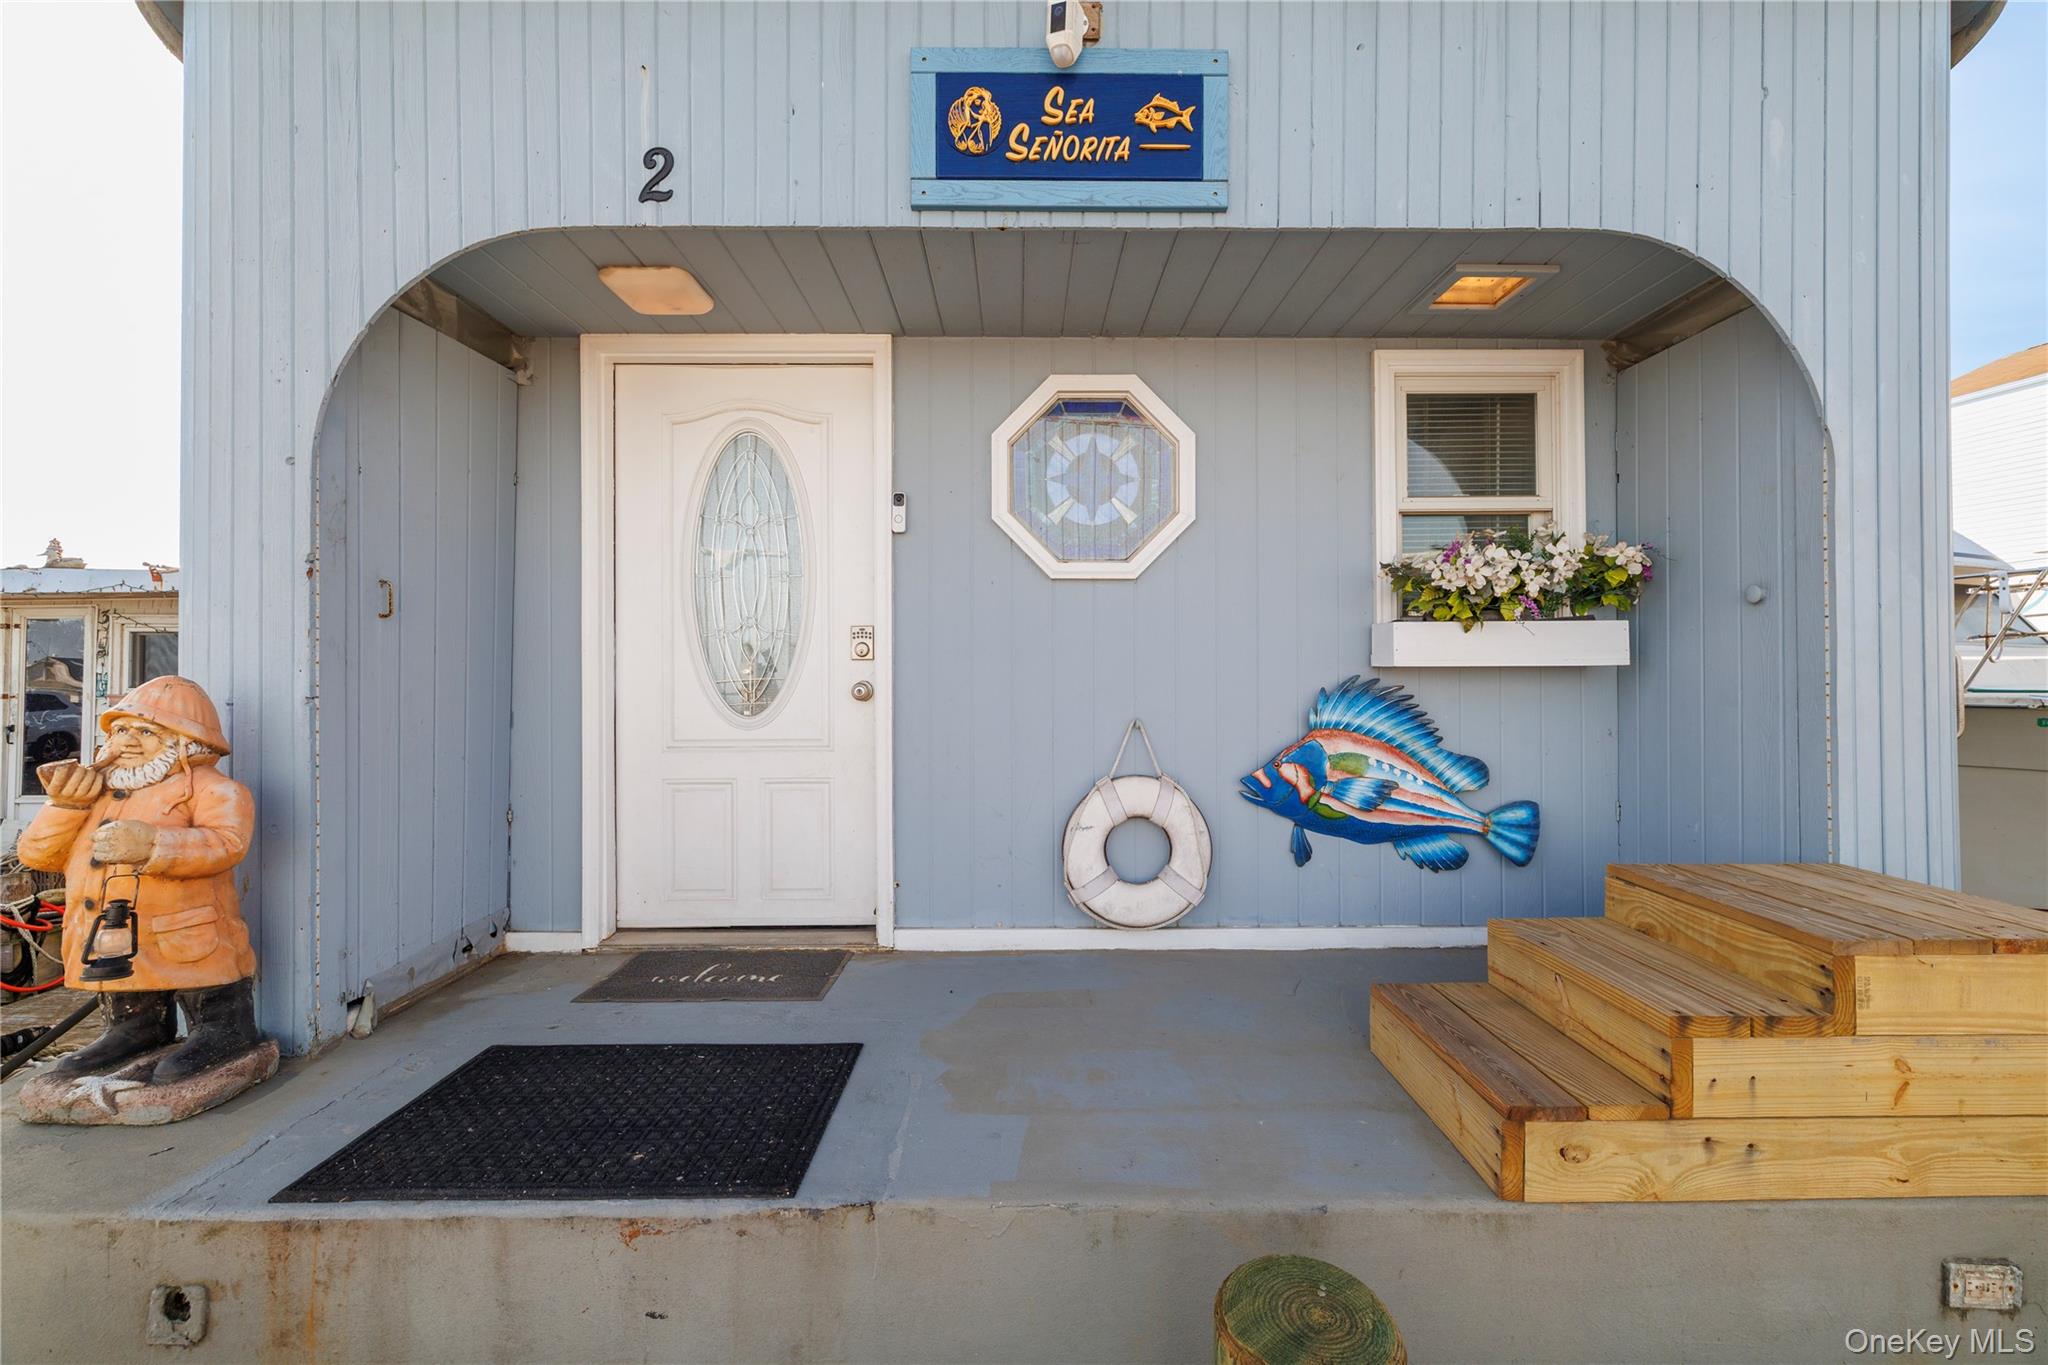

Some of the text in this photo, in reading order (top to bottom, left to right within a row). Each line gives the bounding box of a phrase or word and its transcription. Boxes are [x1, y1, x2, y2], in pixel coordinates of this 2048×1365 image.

[1041, 85, 1095, 125] SEA
[1005, 122, 1130, 162] SEÑORITA
[638, 147, 675, 203] 2
